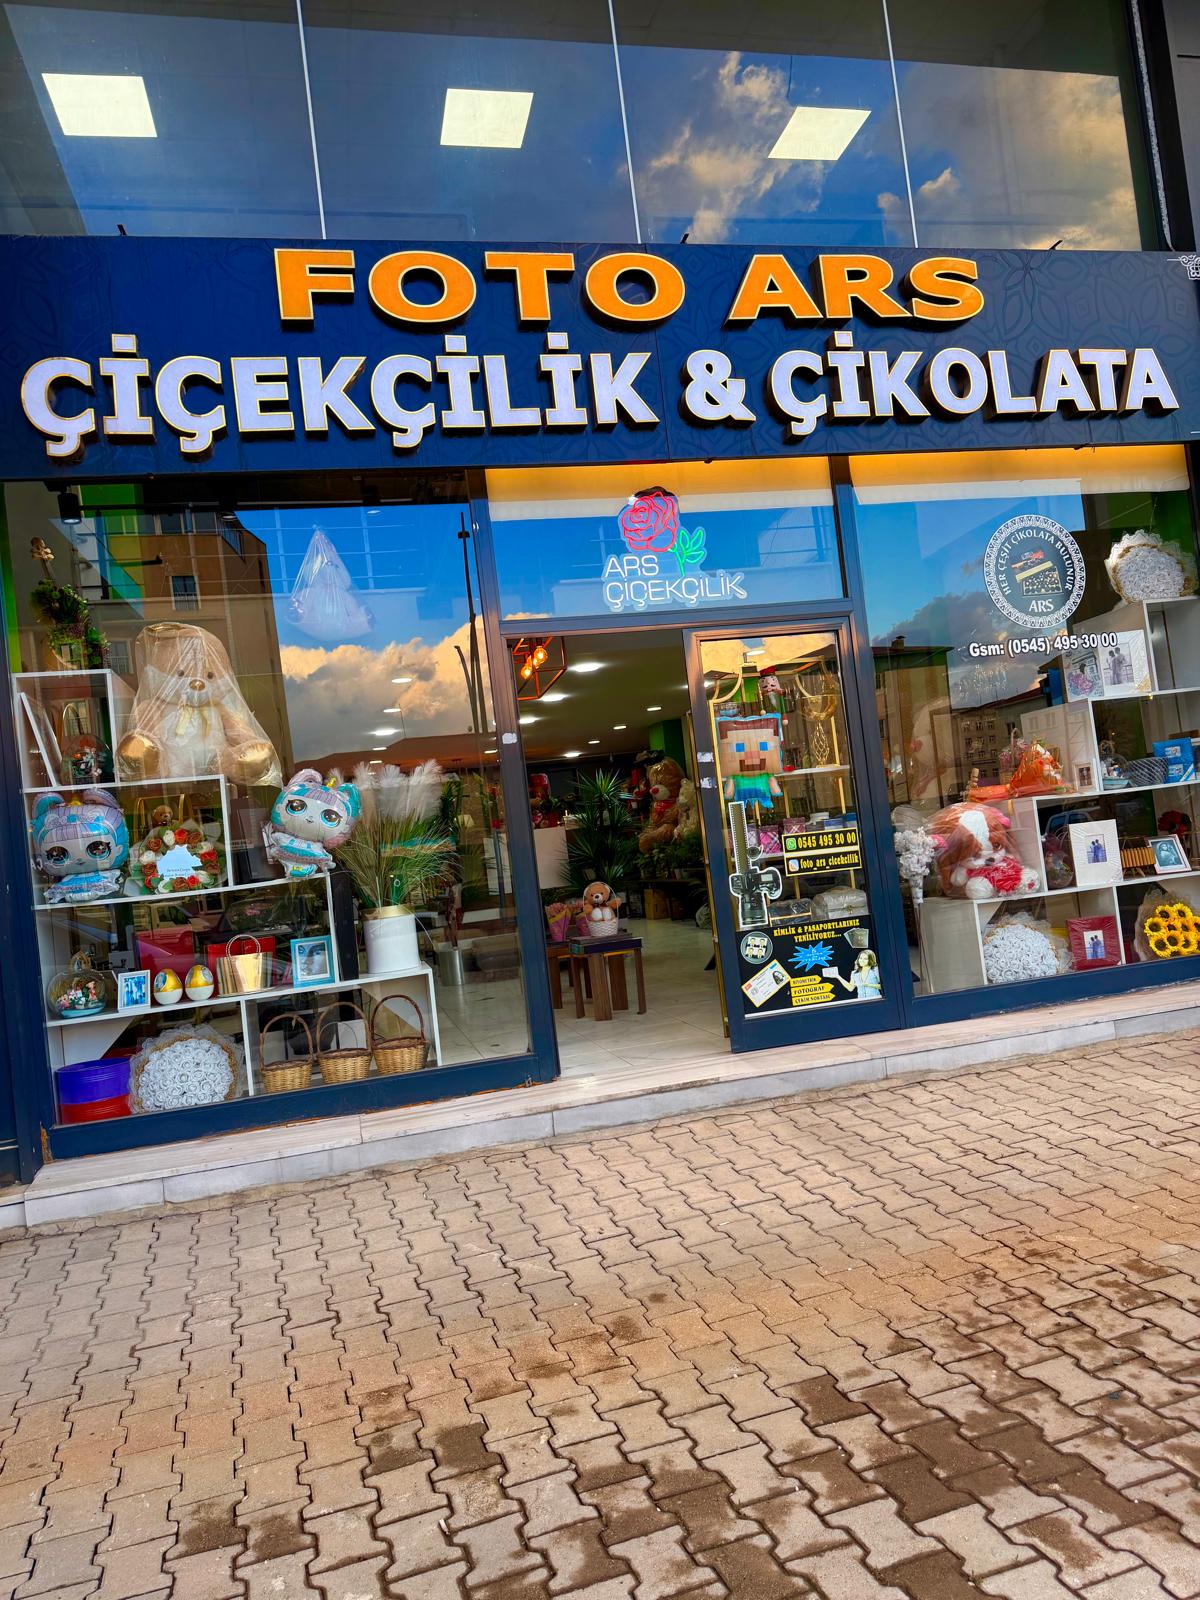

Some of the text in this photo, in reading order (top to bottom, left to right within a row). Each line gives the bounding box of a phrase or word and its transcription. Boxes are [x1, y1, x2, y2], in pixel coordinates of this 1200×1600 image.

[274, 248, 985, 322] FOTO ARS
[21, 330, 1180, 458] ÇİÇEKÇİLİK & ÇİKOLATA
[605, 554, 659, 579] ARS
[997, 529, 1076, 596] HER ÇEŞİT ÇİKOLATA BULUNUR
[606, 573, 746, 609] ÇİÇEKÇİLİK
[1028, 598, 1055, 613] ARS
[969, 632, 1118, 658] Gsm: (0545) 495 30 00
[797, 832, 857, 849] 0545 495 30 00
[773, 919, 860, 937] KİMLİK & PASAPORTLARINIZ
